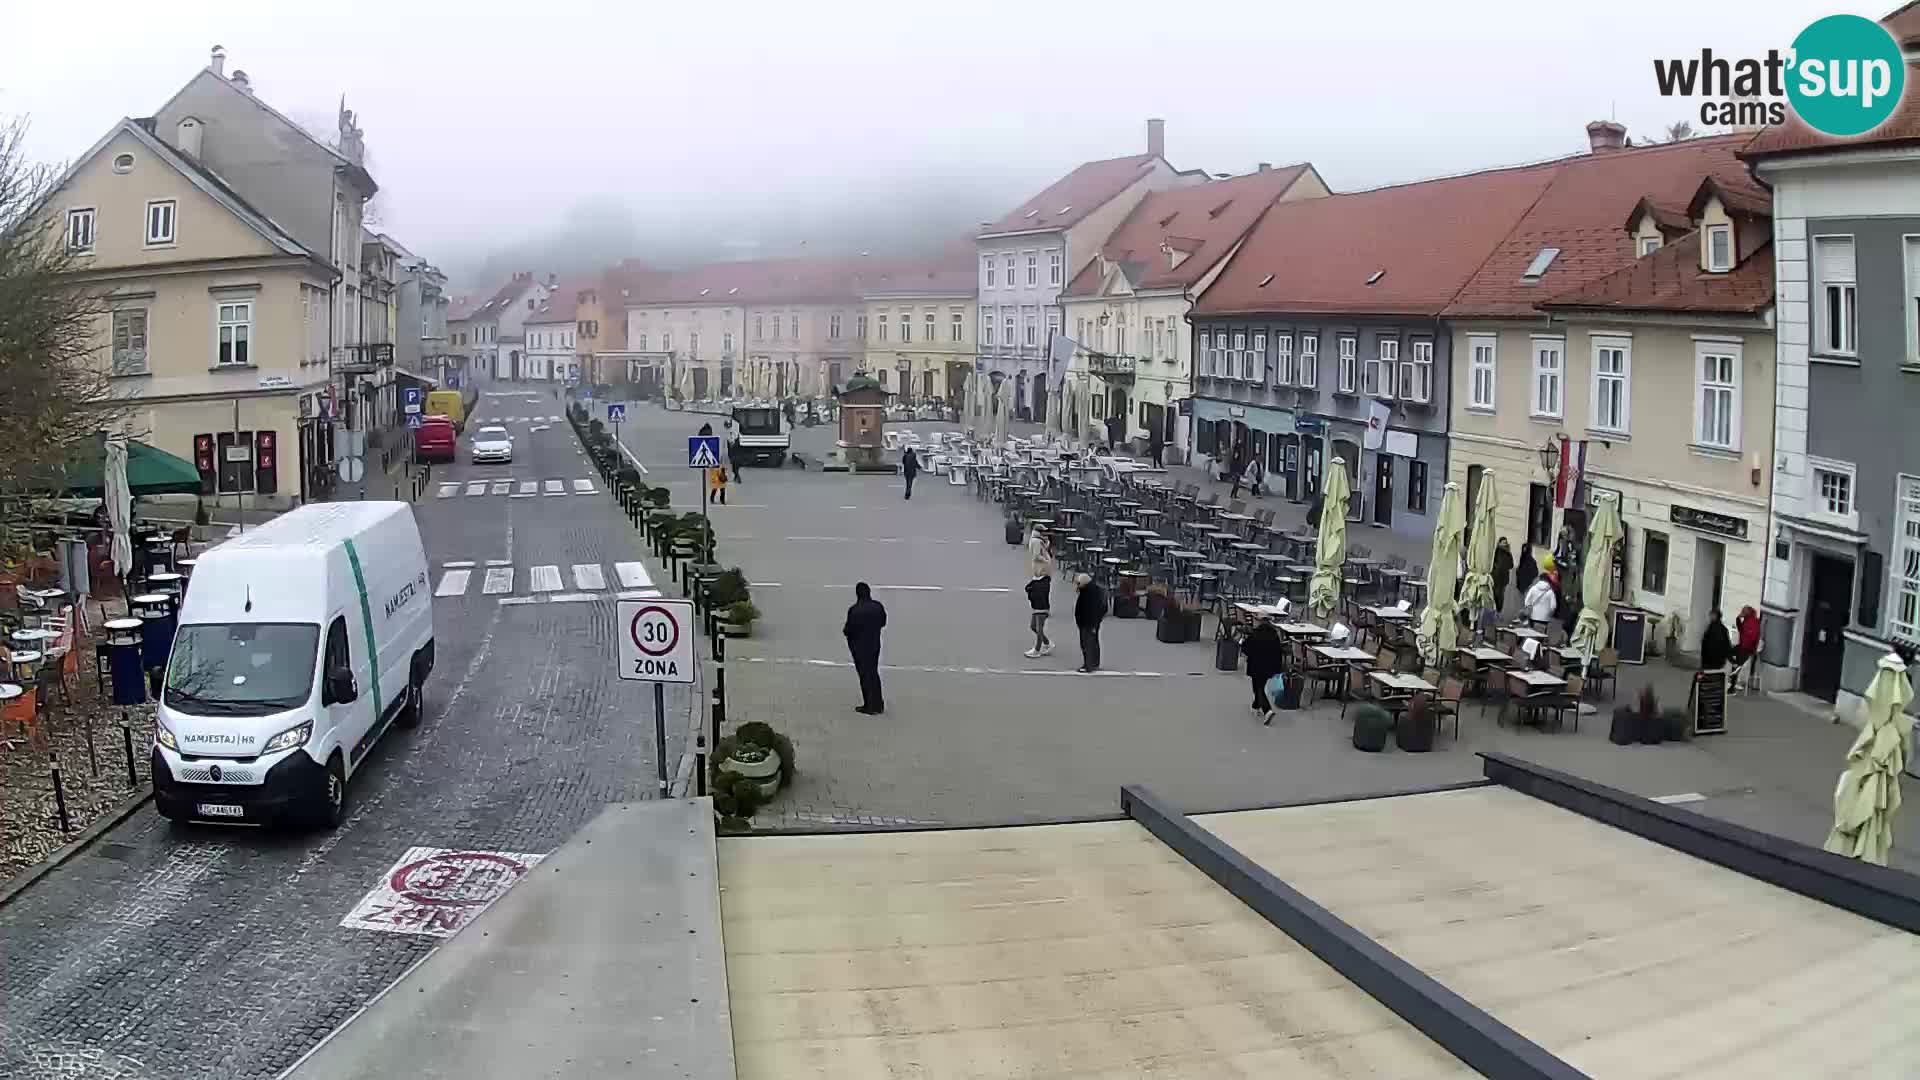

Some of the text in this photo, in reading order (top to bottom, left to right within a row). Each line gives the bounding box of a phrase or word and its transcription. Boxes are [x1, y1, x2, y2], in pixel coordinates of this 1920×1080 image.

[408, 391, 417, 402] P
[643, 622, 668, 643] 30
[634, 659, 678, 676] ZONA
